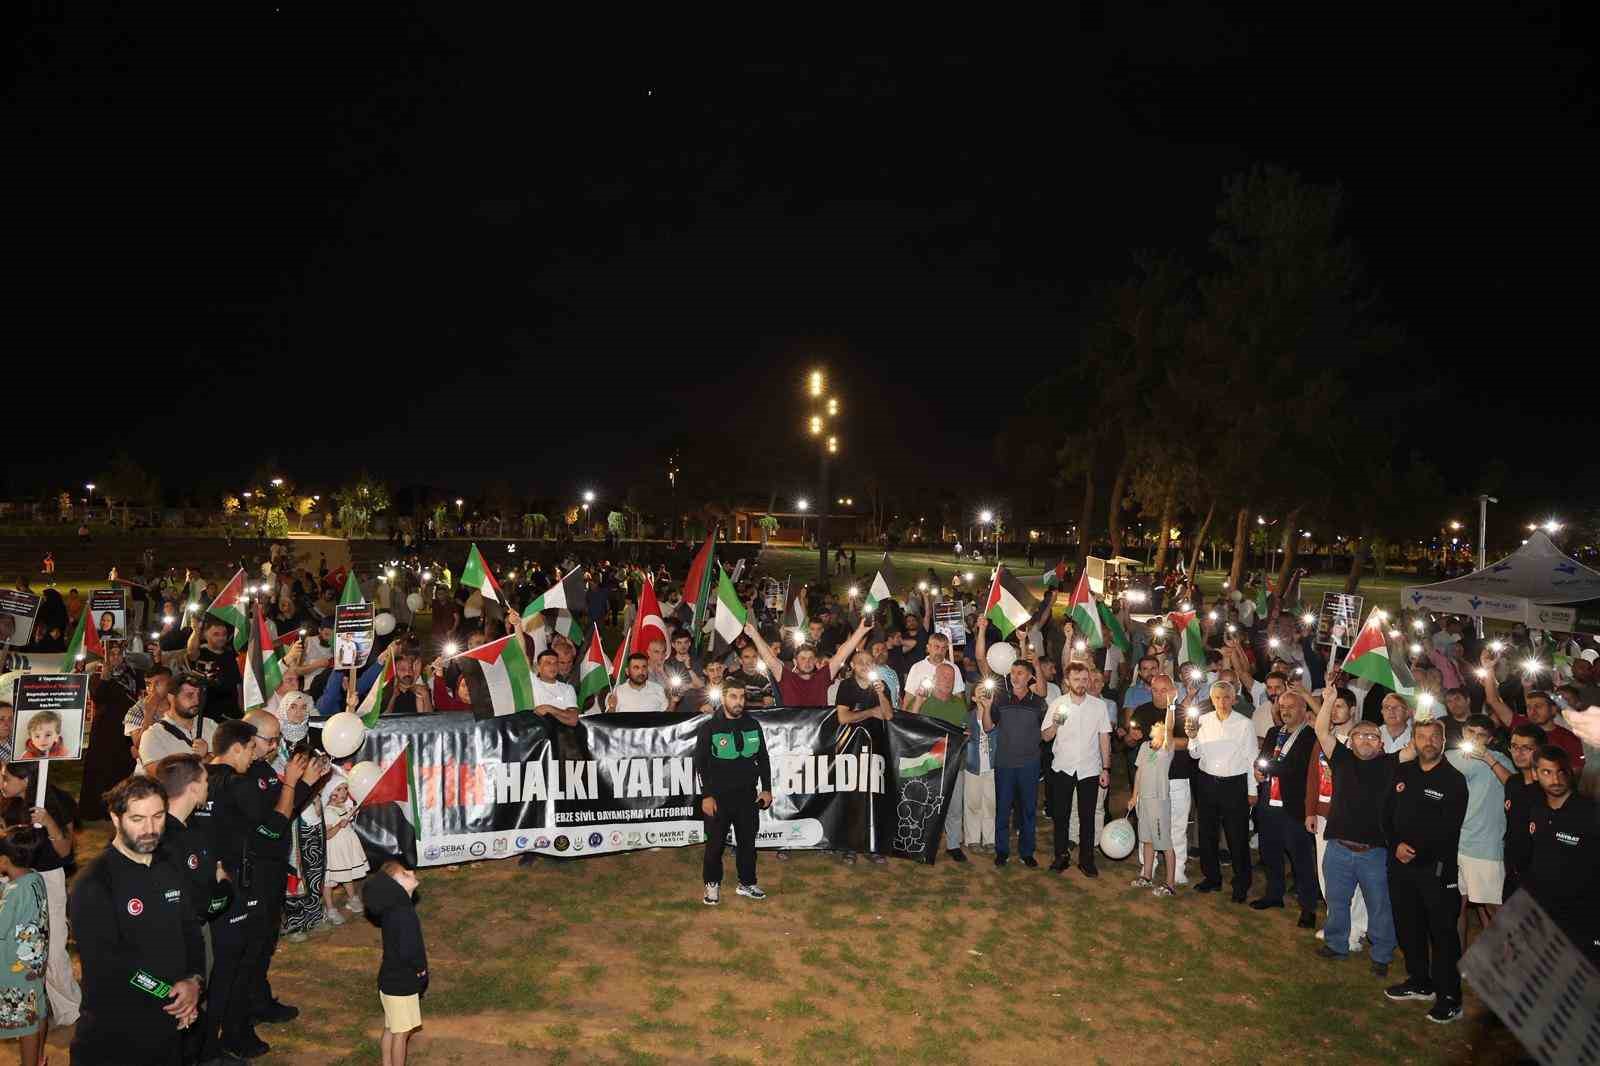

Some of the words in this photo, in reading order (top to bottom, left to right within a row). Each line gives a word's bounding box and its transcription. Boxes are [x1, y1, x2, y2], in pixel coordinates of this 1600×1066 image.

[496, 759, 599, 804] HALKI
[575, 809, 597, 822] SİVİL
[597, 808, 644, 821] DAYANIŞMA
[645, 806, 694, 819] PLATFORMU
